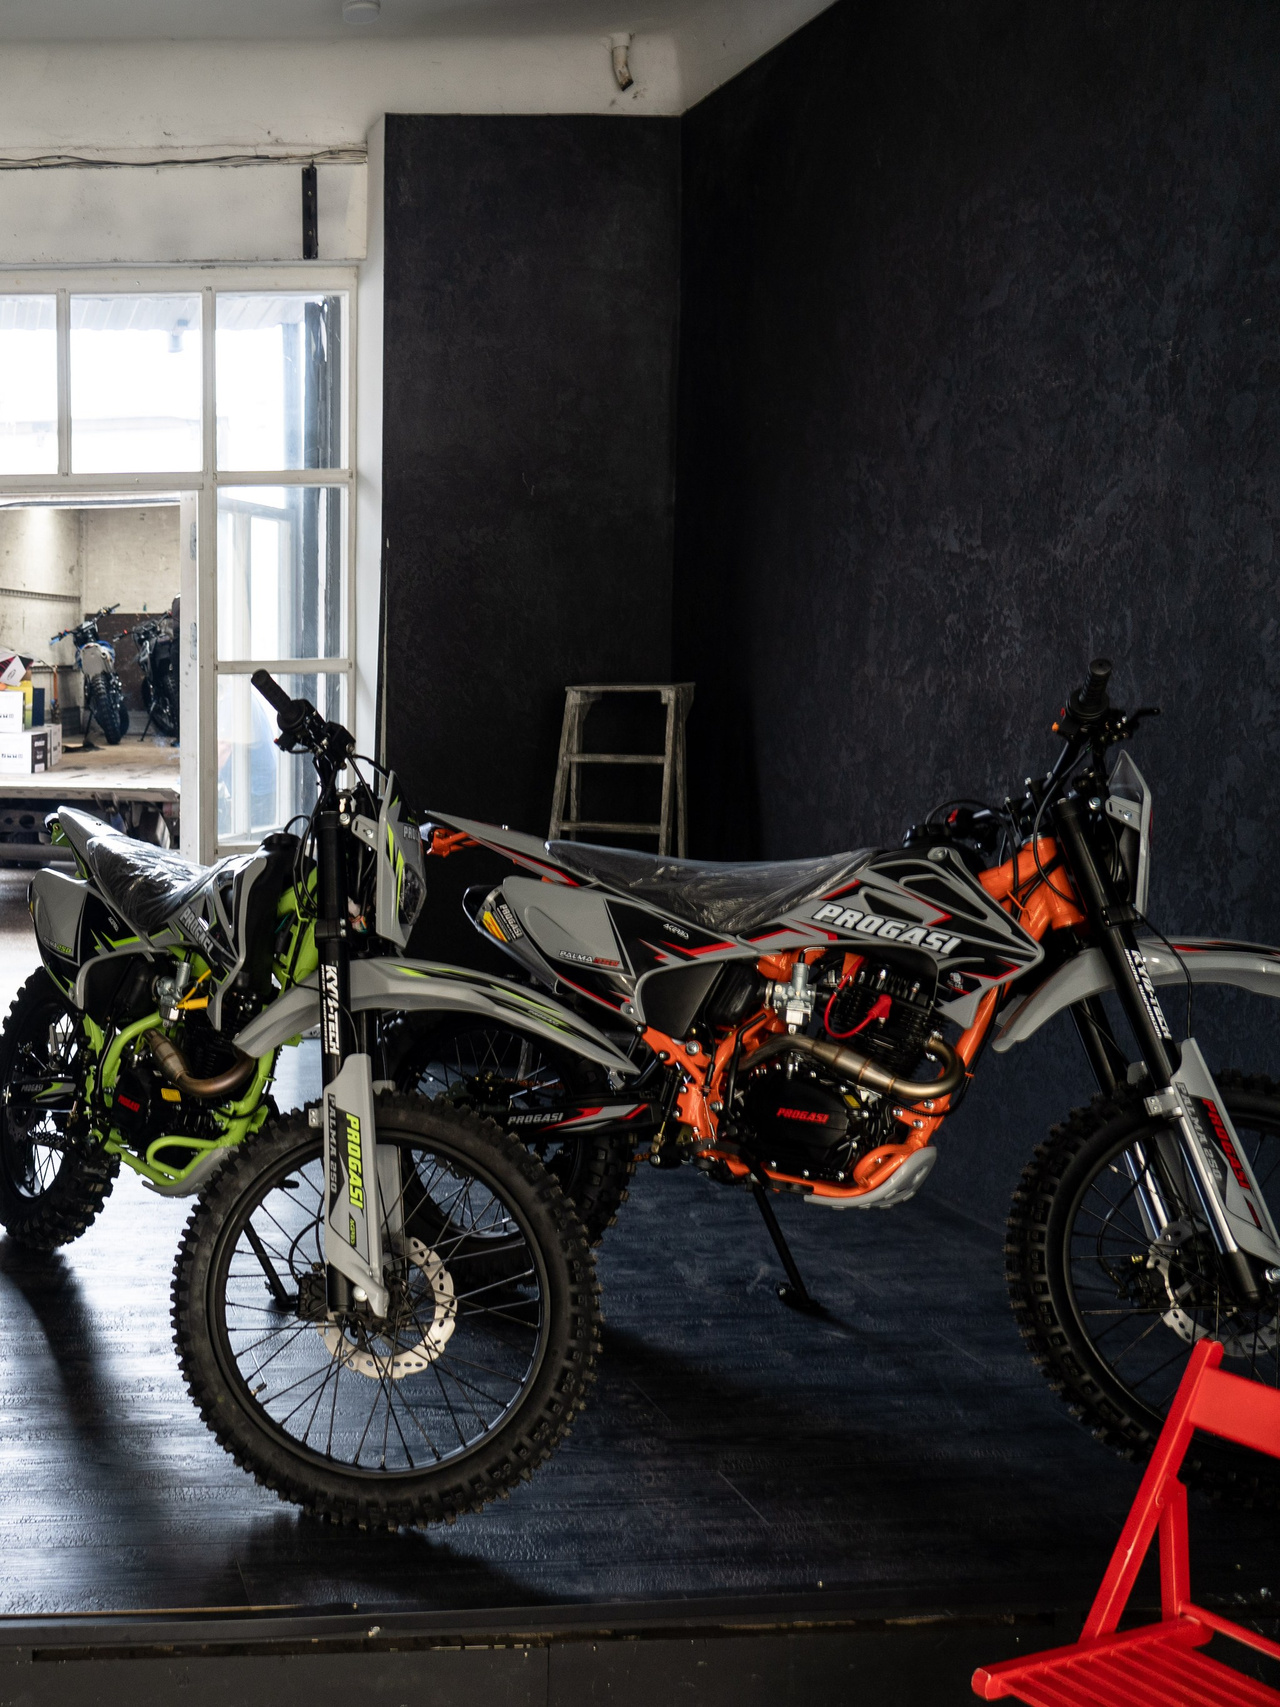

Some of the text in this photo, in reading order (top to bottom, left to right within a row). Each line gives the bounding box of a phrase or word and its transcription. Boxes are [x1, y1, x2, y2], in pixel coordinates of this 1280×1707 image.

[499, 904, 523, 937] PROGASI
[811, 902, 963, 955] PROGASI
[559, 950, 594, 964] PALMA
[21, 1083, 44, 1092] PROGASI
[507, 1112, 565, 1125] PROGASI
[776, 1107, 830, 1125] PROGASI
[1175, 1082, 1223, 1181] PALMA 250
[327, 1093, 338, 1195] PALMA 250
[346, 1112, 365, 1210] PROGASI
[1201, 1097, 1252, 1190] PROGASI
